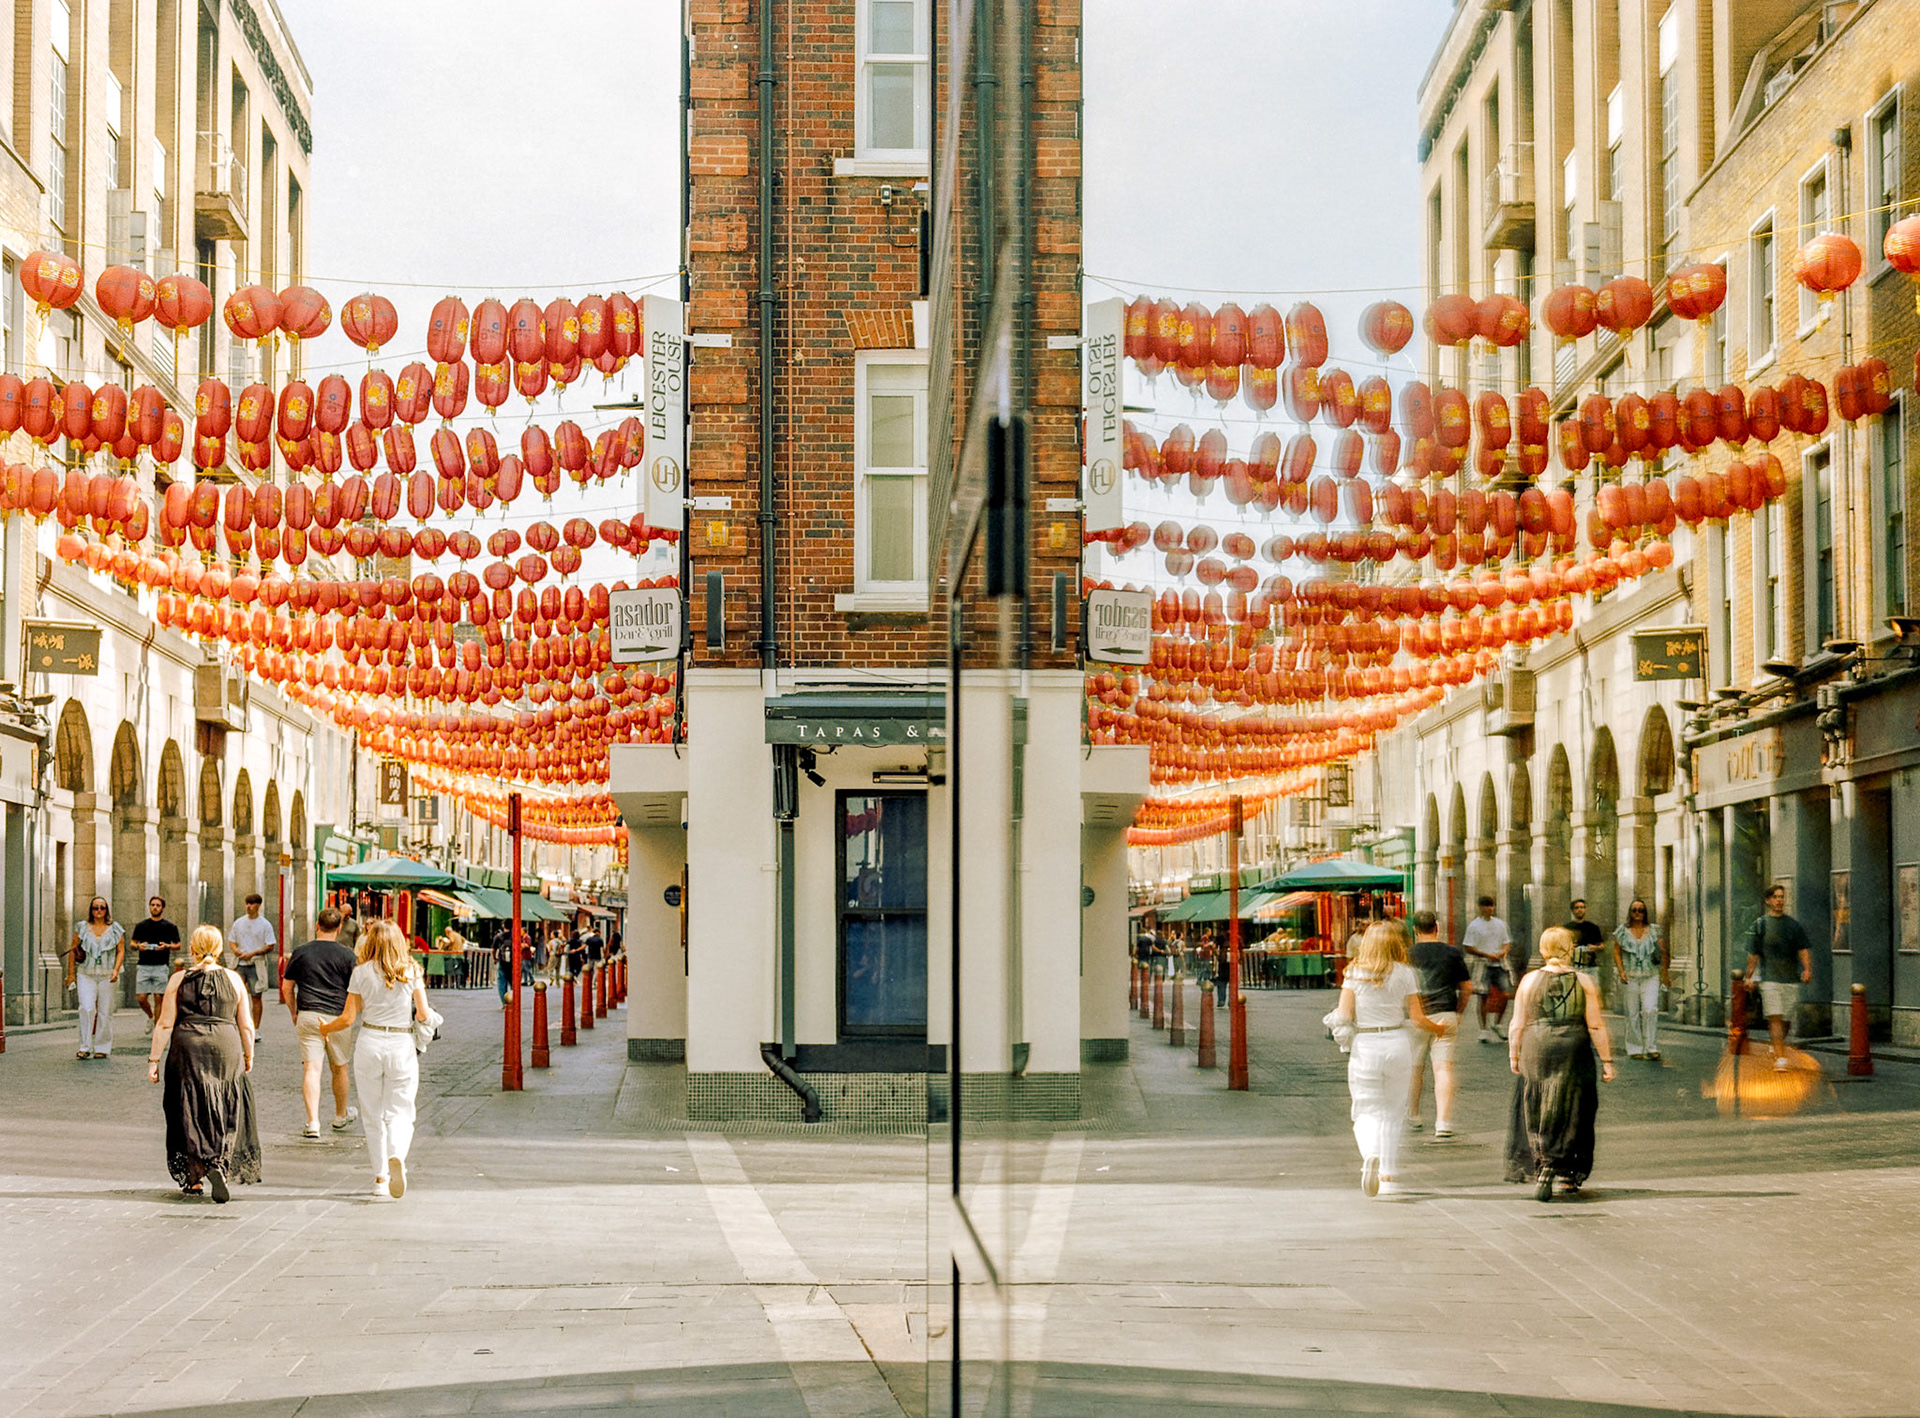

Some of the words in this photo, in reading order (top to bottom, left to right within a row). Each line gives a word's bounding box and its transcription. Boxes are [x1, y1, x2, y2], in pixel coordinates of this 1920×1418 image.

[652, 331, 666, 440] LEICESTER
[614, 597, 674, 627] asador
[797, 724, 880, 738] TAPAS
[906, 724, 919, 738] &
